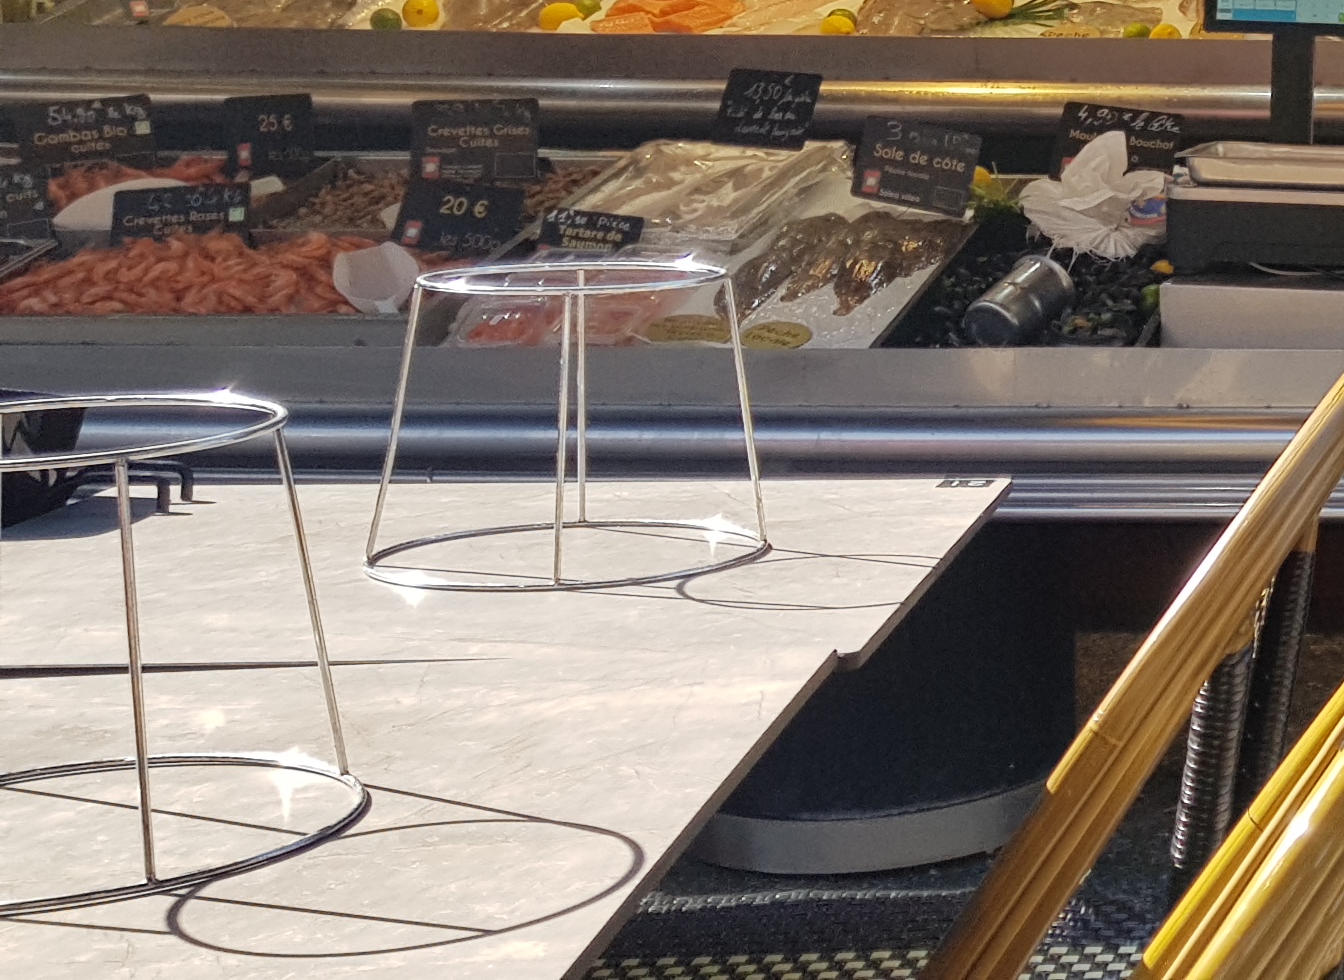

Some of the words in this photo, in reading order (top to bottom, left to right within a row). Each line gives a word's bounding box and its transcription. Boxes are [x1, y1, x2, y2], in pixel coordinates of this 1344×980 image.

[258, 114, 279, 132] 25
[282, 114, 294, 132] €
[427, 124, 489, 137] Crevettes
[493, 123, 530, 136] Grises
[33, 129, 100, 145] Gambas
[459, 136, 499, 148] Cuites
[1129, 136, 1175, 150] Bouchot
[873, 143, 905, 161] Sole
[909, 150, 928, 166] de
[932, 156, 966, 173] côte
[440, 195, 468, 215] 20
[474, 200, 489, 218] €
[559, 224, 605, 239] Tartare
[607, 230, 623, 242] de
